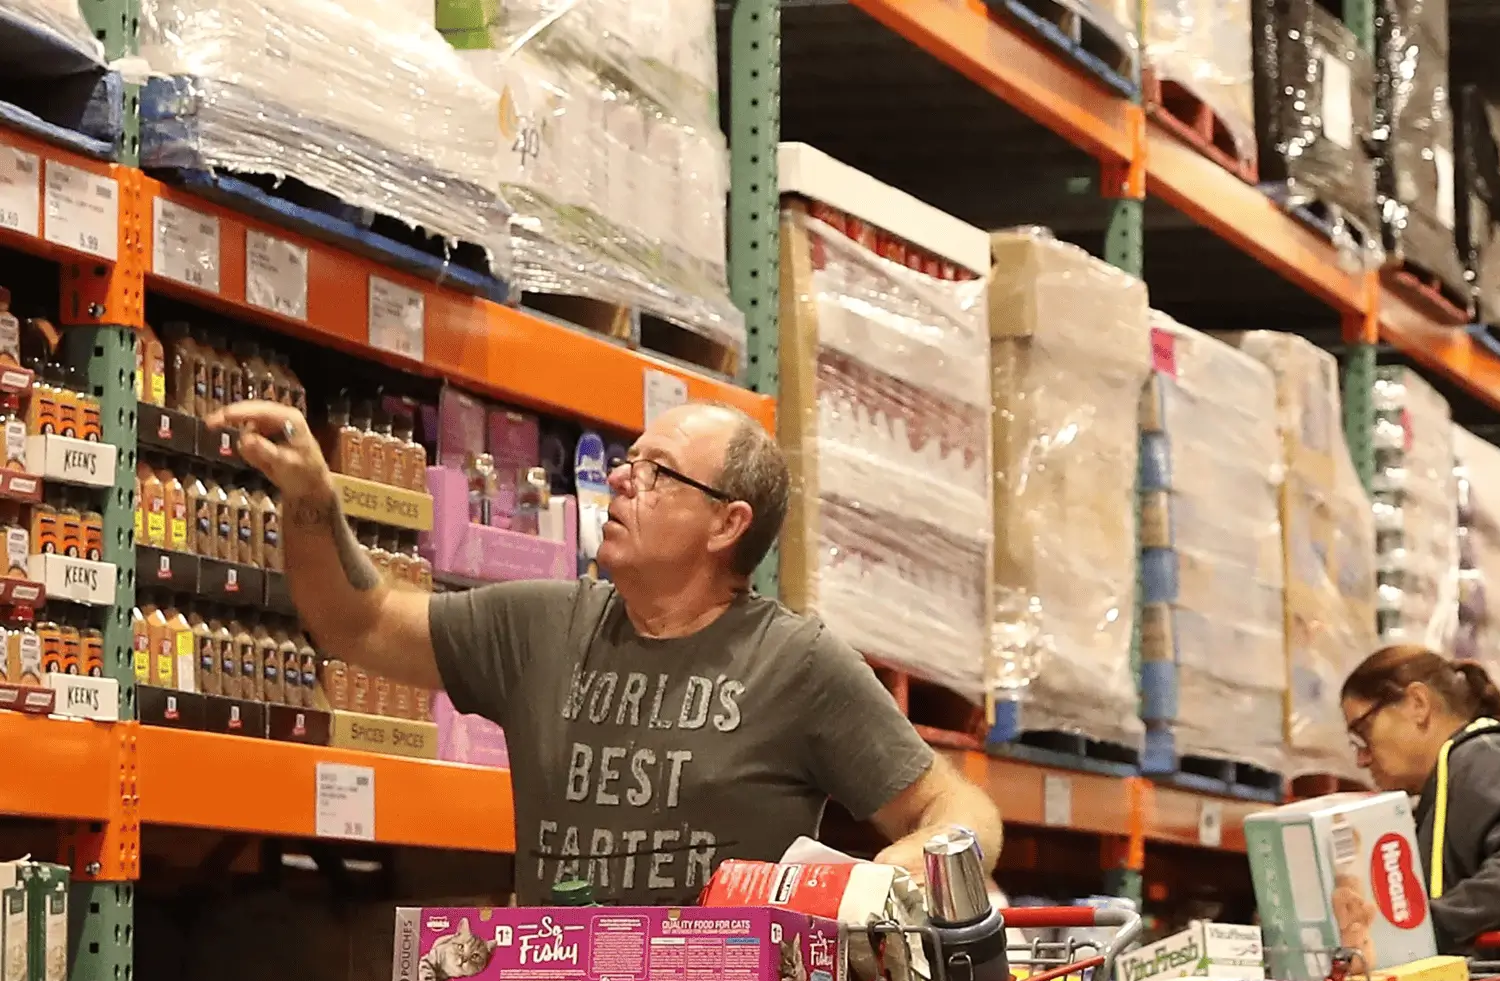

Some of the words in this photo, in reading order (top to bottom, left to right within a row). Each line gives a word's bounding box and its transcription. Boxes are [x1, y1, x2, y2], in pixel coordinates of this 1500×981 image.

[63, 448, 98, 476] KEEN'S
[64, 564, 98, 592] KEEN'S
[66, 685, 100, 712] KEEN'S
[560, 662, 747, 733] WORLD'S
[565, 742, 694, 808] BEST
[536, 819, 719, 890] FARTER
[538, 915, 563, 938] So
[661, 919, 693, 930] QUALITY
[693, 920, 715, 930] FOOD
[715, 920, 730, 930] FOR
[730, 920, 751, 930] CATS
[401, 920, 413, 977] POUCHES
[518, 933, 579, 965] Fishy
